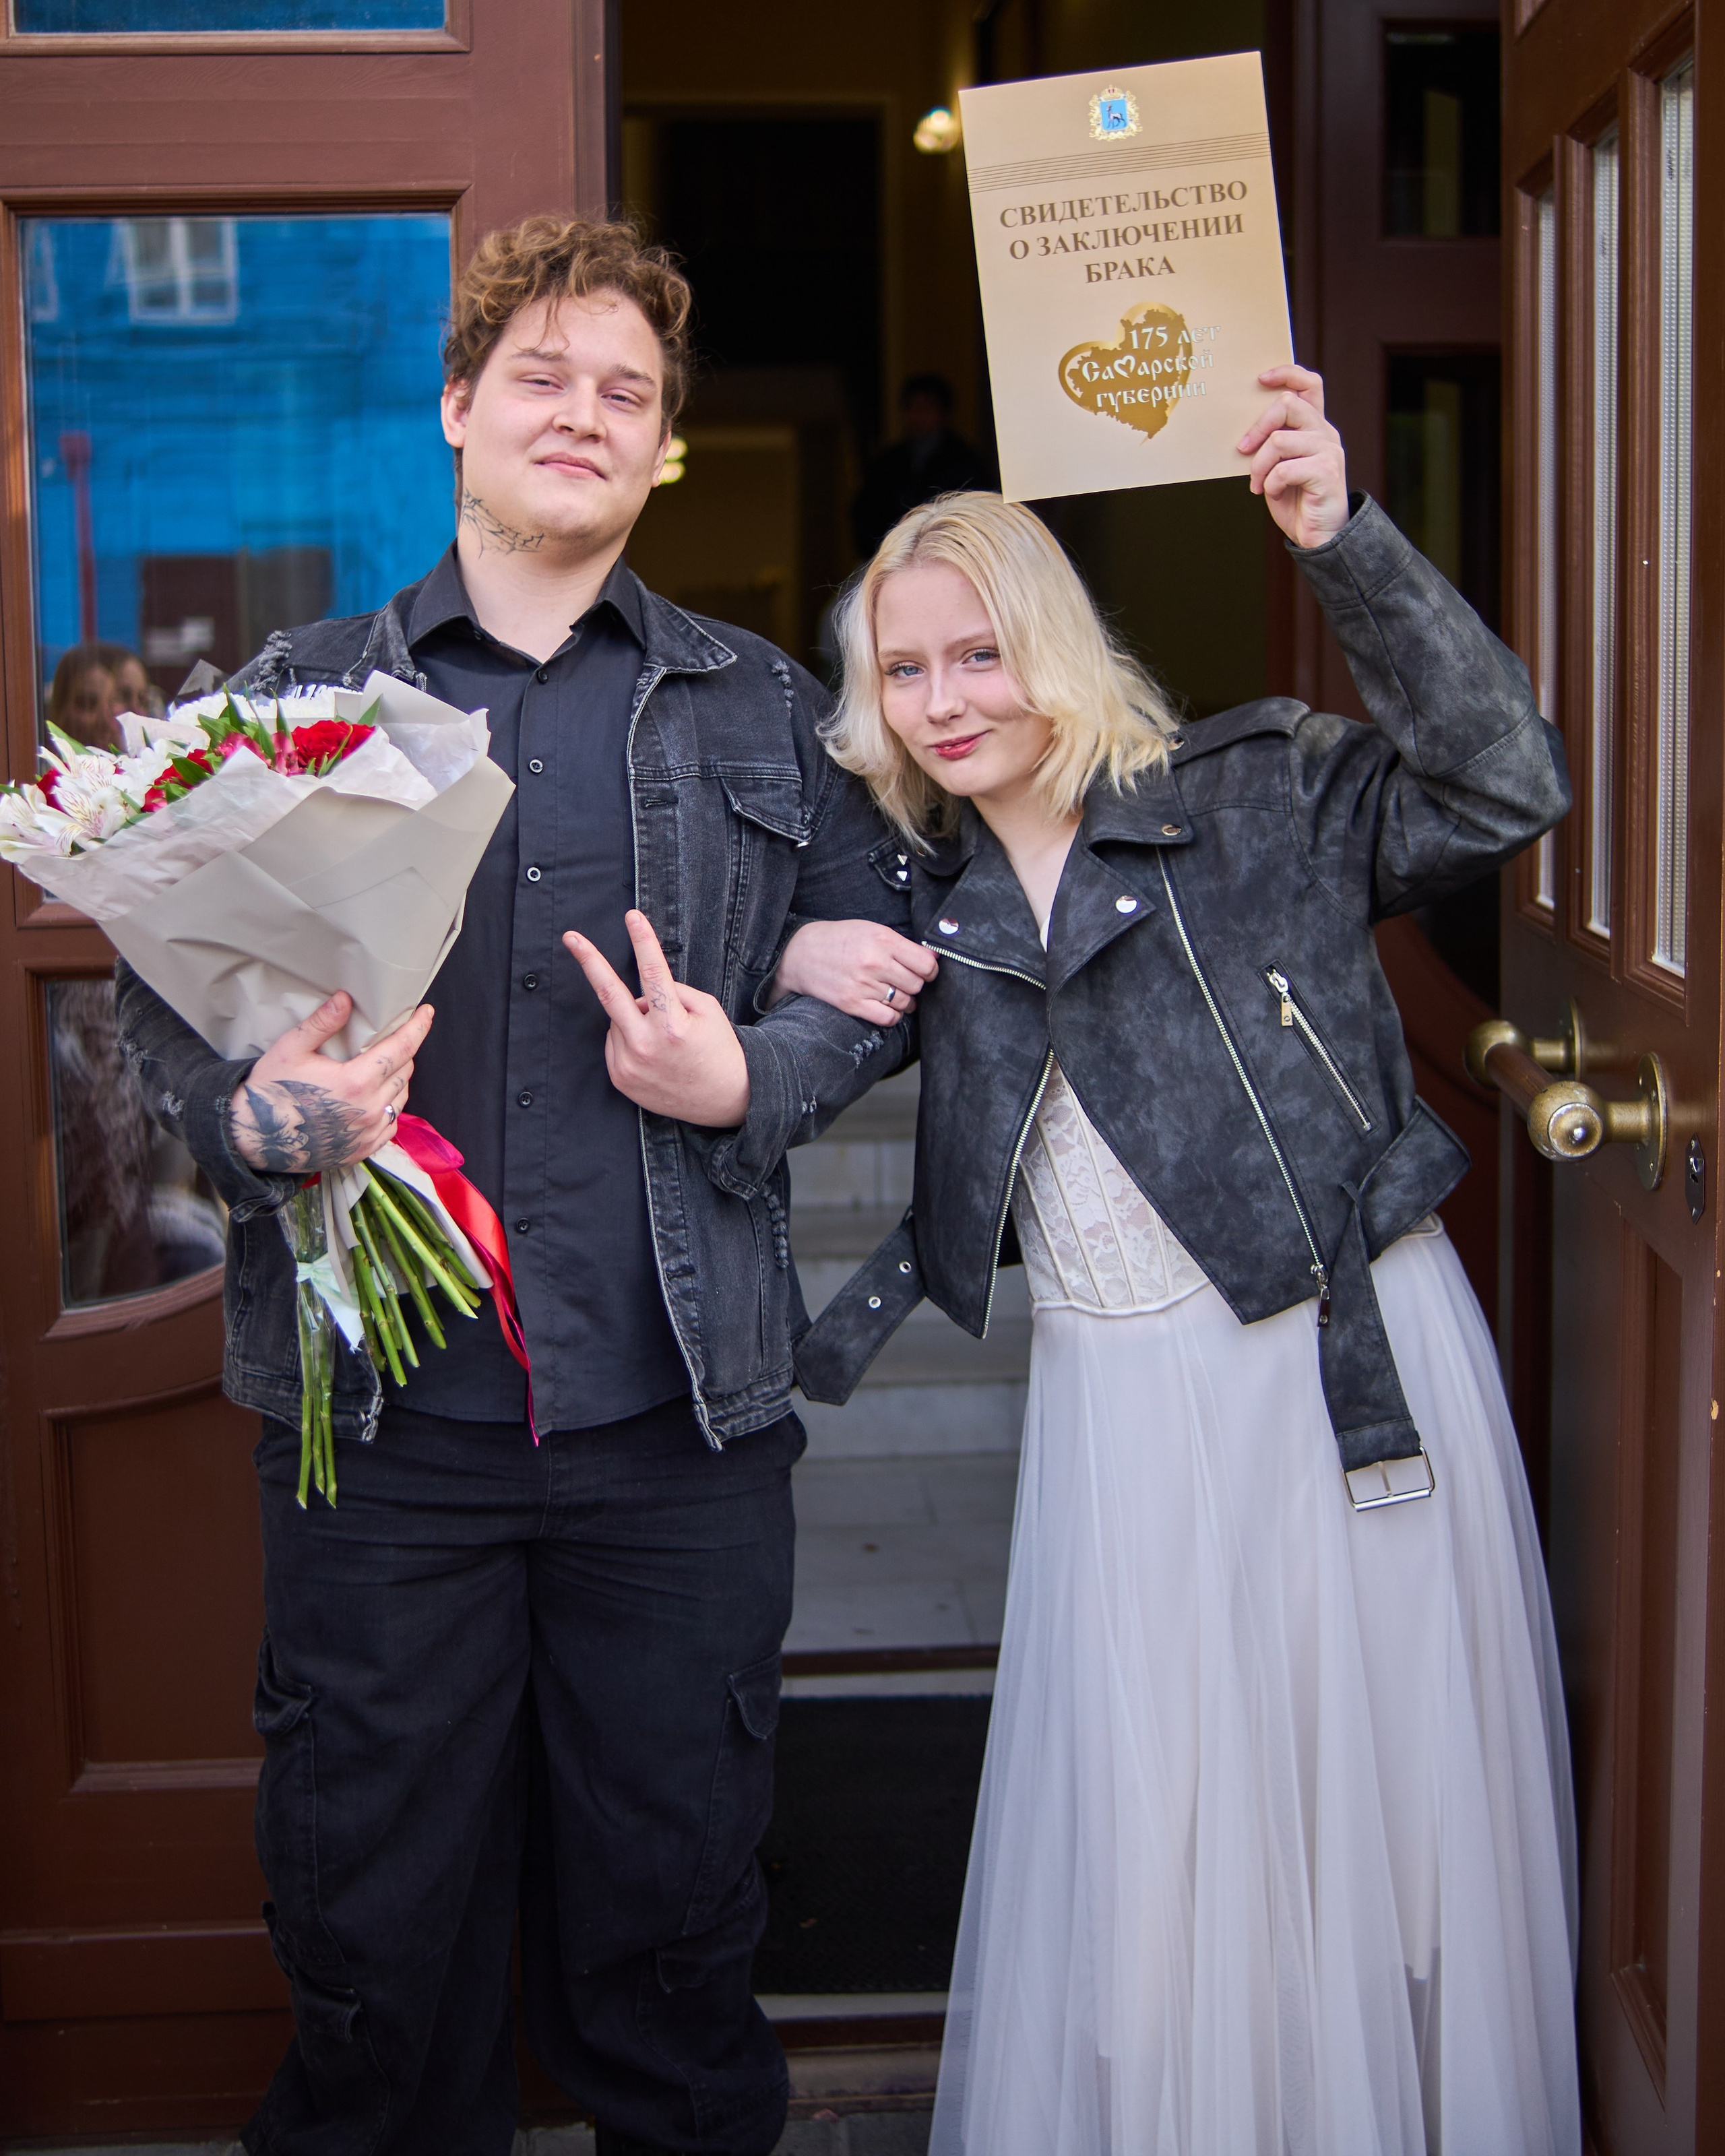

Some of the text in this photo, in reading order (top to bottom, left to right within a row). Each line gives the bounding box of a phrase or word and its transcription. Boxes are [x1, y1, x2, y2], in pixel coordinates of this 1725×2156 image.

[1000, 180, 1247, 228] СВИДЕТЕЛЬСТВО
[1009, 214, 1245, 260] О ЗАКЛЮЧЕНИИ
[1085, 255, 1175, 284] БРАКА
[1129, 326, 1168, 350] 175
